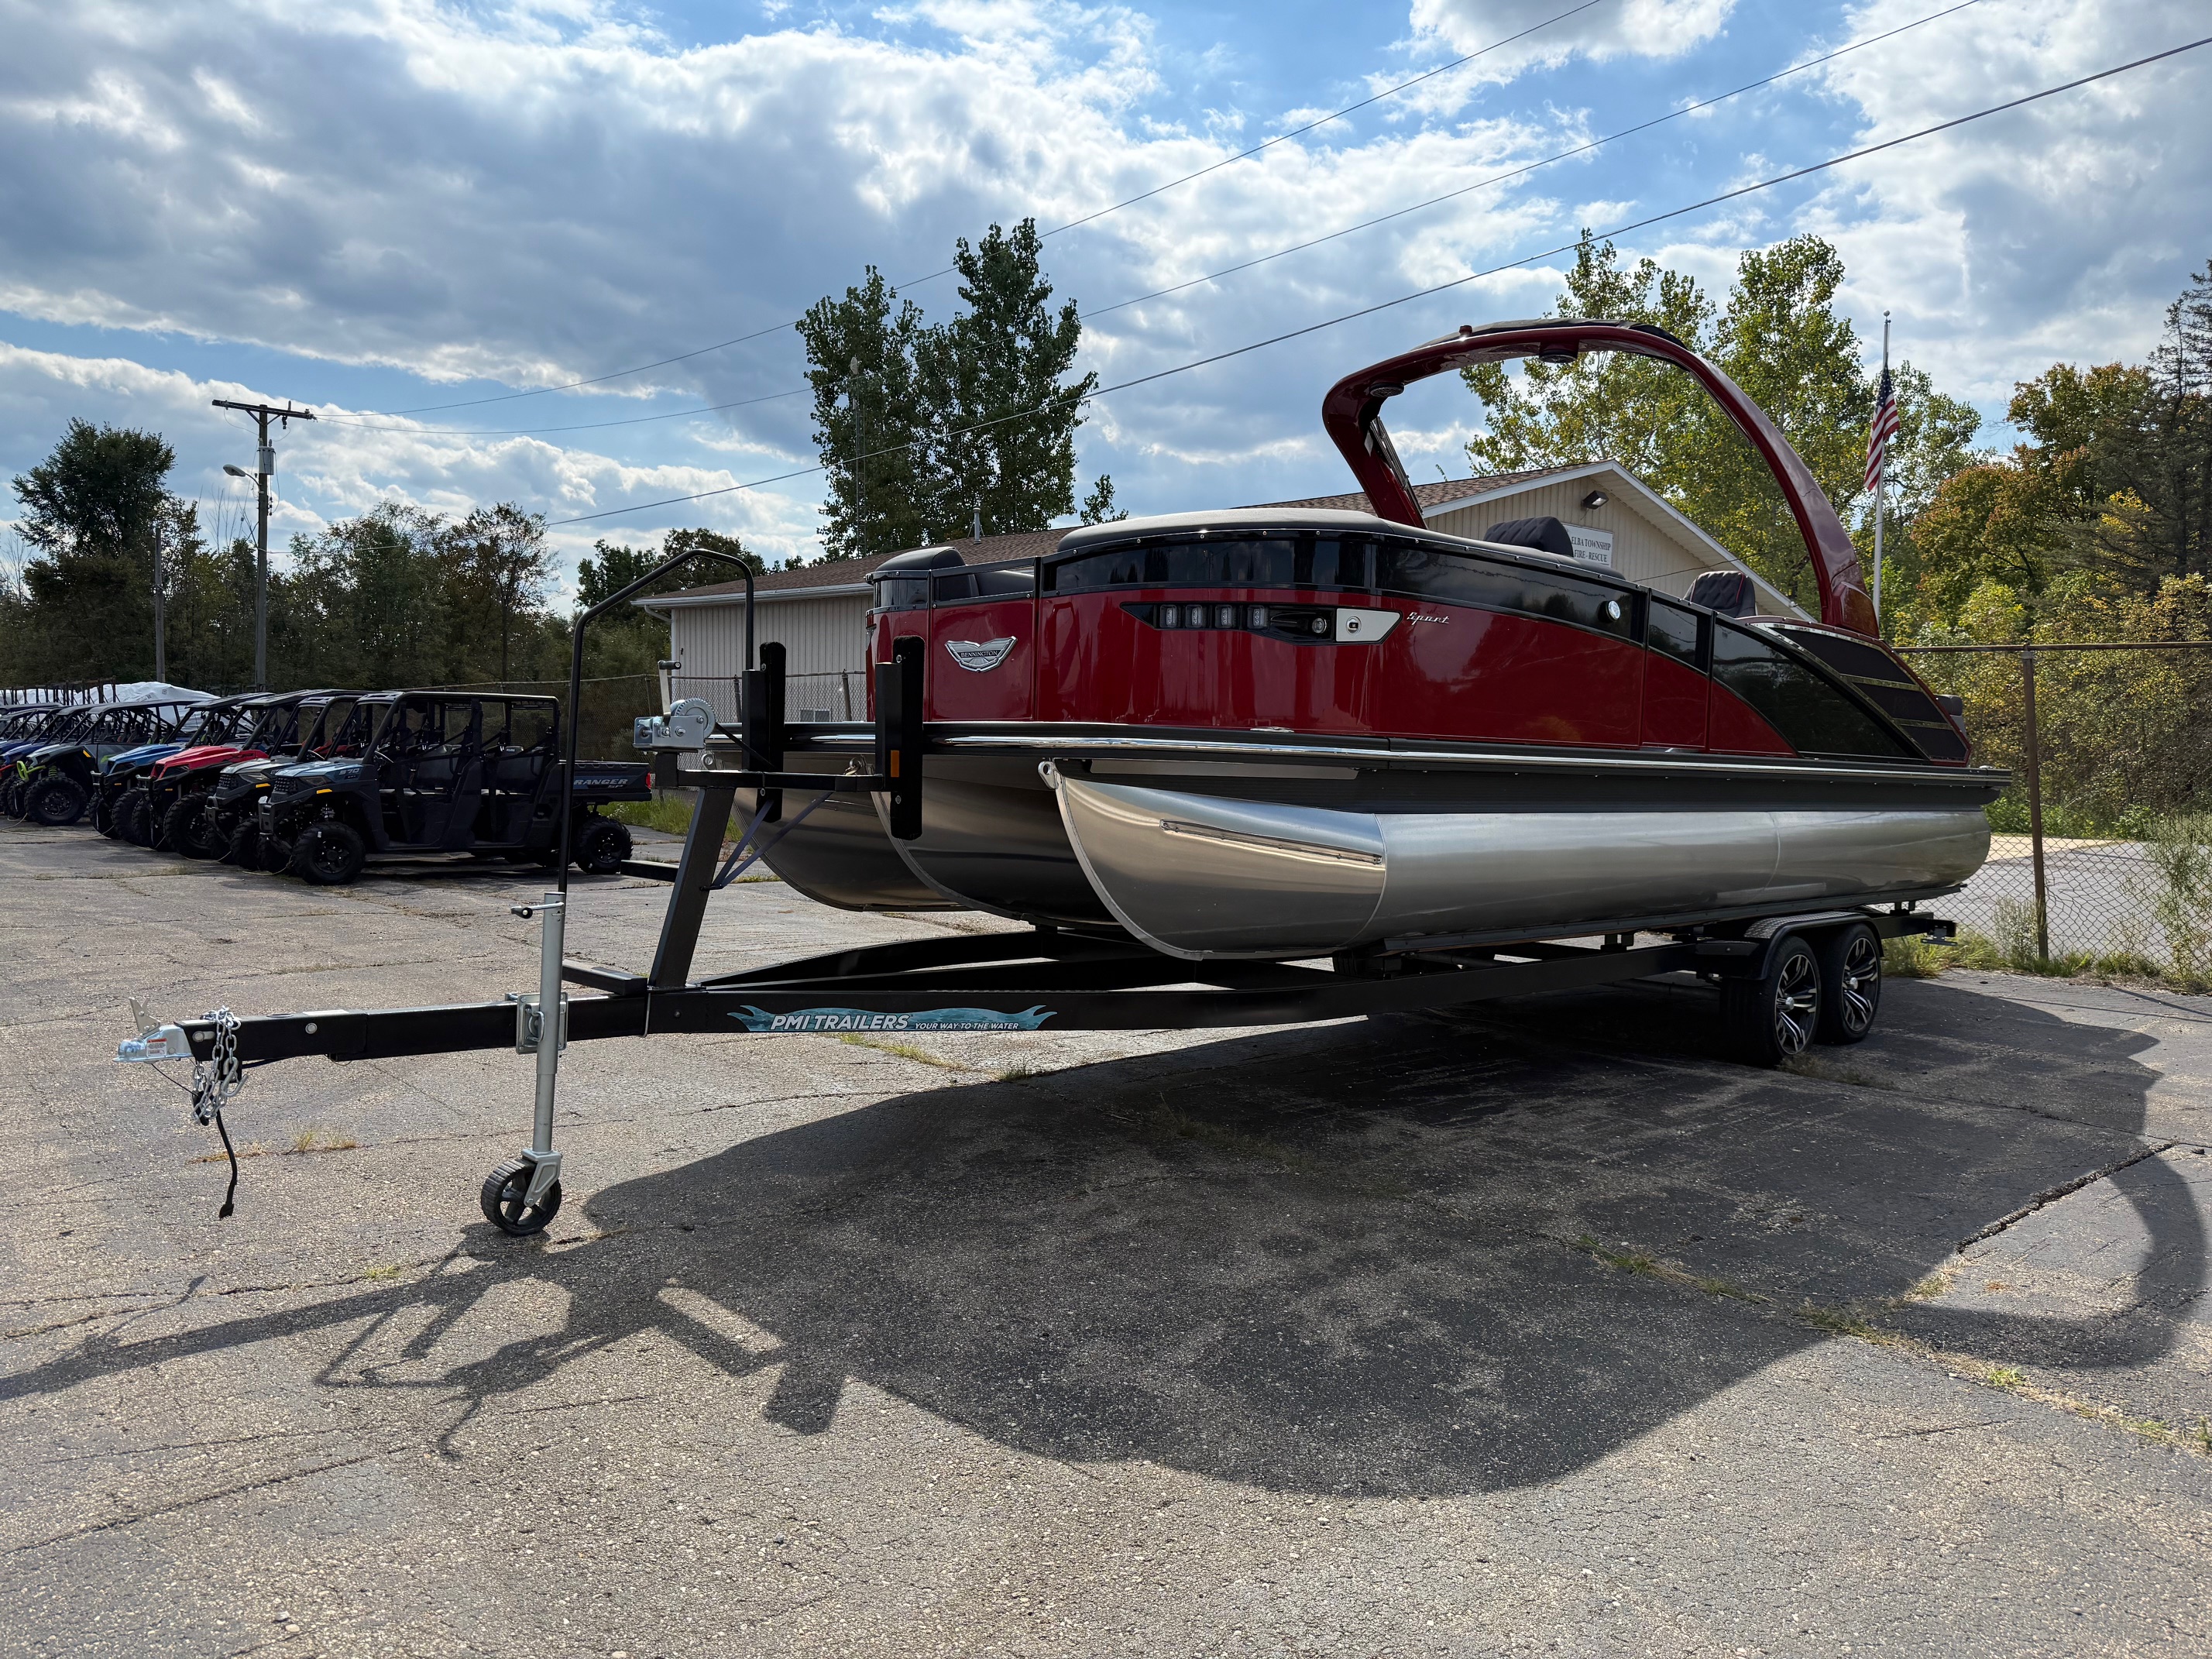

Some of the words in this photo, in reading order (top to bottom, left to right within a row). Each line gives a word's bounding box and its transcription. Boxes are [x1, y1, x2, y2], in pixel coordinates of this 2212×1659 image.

[1571, 537, 1585, 547] ELBA
[1585, 539, 1611, 551] TOWNSHIP
[1575, 550, 1585, 558] FIRE
[1589, 552, 1608, 562] RESCUE
[1407, 612, 1450, 625] Sport
[770, 1015, 811, 1030] PMI
[813, 1015, 910, 1030] TRAILERS
